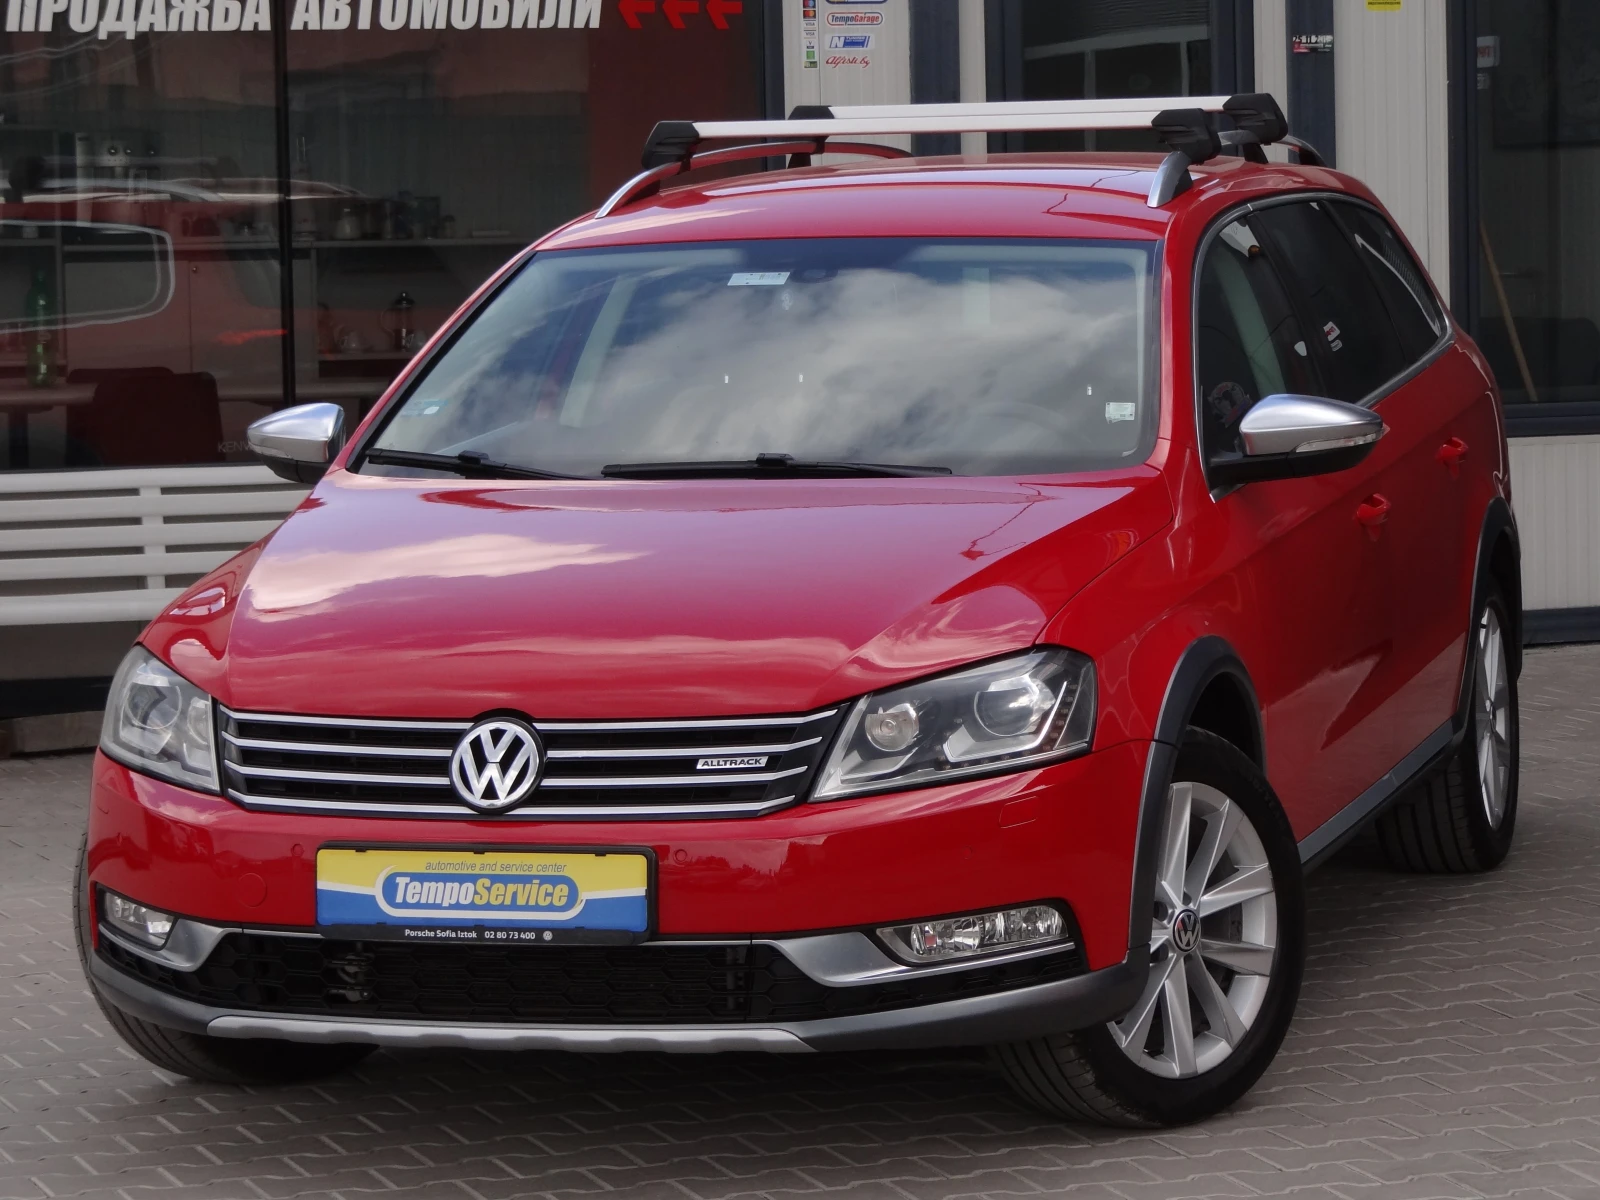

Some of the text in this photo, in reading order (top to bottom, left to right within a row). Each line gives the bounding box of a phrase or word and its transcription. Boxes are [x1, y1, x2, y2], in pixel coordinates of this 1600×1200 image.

[5, 0, 601, 39] ПРОДАЖБА АВТОМОБИЛИ
[831, 14, 880, 24] TempoGarage
[701, 758, 762, 767] ALLTRACK
[425, 860, 567, 873] automotive and service center
[395, 876, 569, 907] TempoService
[405, 929, 536, 940] Porsche Sofia Iztok 02 80 73 400
